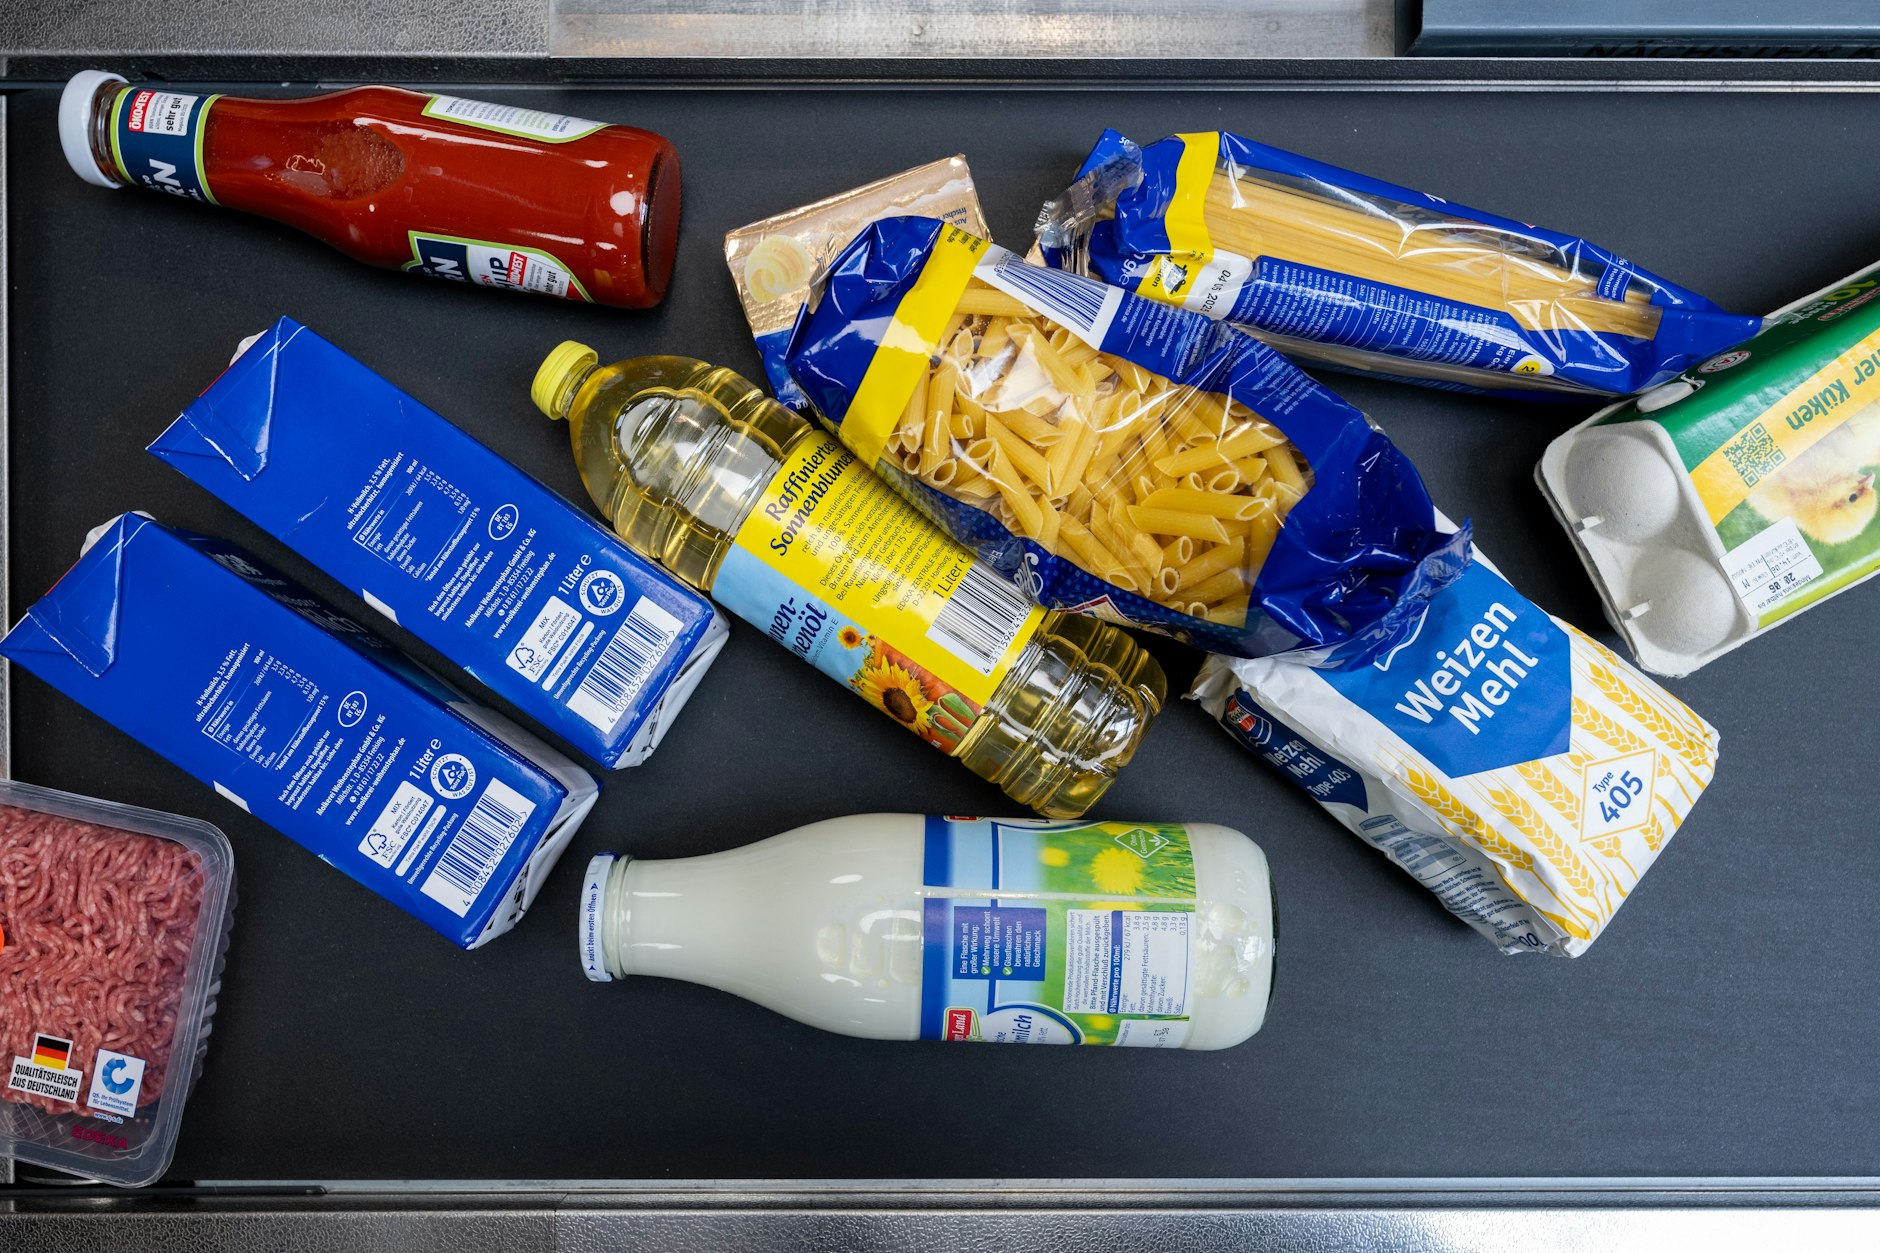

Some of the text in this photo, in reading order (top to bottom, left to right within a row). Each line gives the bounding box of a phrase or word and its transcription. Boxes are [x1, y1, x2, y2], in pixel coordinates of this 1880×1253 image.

[172, 97, 183, 109] gut
[1786, 379, 1851, 430] Küken
[347, 485, 372, 513] H-Vollmilch,
[378, 458, 390, 470] Fett,
[347, 452, 403, 529] ultrahocherhitzt, homogenisiert
[766, 440, 836, 521] Raffiniertes
[801, 533, 816, 553] reich
[823, 483, 852, 520] natürlichem
[810, 493, 857, 556] und ungesättigten
[828, 502, 892, 589] Braten zum Anrichten
[879, 525, 902, 553] Gebrauch
[894, 535, 906, 547] 175
[819, 564, 837, 586] Dieses
[855, 521, 866, 534] sich
[843, 534, 884, 588] Raumtemperatur
[872, 531, 924, 602] Ungeöffnet mindestens
[904, 551, 920, 573] oberer
[465, 604, 484, 627] Molkerei
[481, 566, 511, 604] Weihenstephan
[508, 549, 522, 566] GmbH
[484, 550, 534, 617] Milchstr. Freising
[562, 564, 583, 588] Liter
[580, 572, 598, 595] SCHÜTZT
[896, 558, 935, 611] EDEKA ZENTRALE
[937, 563, 961, 591] Liter
[598, 595, 608, 606] Tetra
[601, 607, 613, 615] WAS
[613, 595, 623, 608] GUT
[912, 578, 933, 606] D-22291
[538, 616, 549, 628] MIX
[558, 615, 576, 640] C014047
[819, 626, 834, 649] Vitamin
[987, 630, 1014, 662] 311596
[196, 676, 220, 705] H-Vollmilch,
[225, 649, 238, 661] Fett,
[528, 654, 544, 672] FSC
[614, 674, 644, 711] 008452
[640, 636, 672, 673] 027602
[1395, 602, 1517, 724] Weizen
[196, 643, 249, 721] ultrahocherhitzt, homogenisiert
[553, 666, 579, 698] Umweltgerechte
[1449, 640, 1538, 735] Mehl
[413, 748, 433, 772] Liter
[1263, 739, 1308, 767] Weizen
[1287, 752, 1326, 779] Mehl
[316, 791, 335, 815] Molkerei
[332, 753, 362, 792] Weihenstephan
[358, 735, 372, 752] GmbH
[335, 736, 384, 804] Milchstr. Freising
[432, 756, 450, 780] SCHÜTZT
[1592, 772, 1613, 792] Type
[466, 779, 474, 790] GUT
[1306, 768, 1352, 797] Type 405
[1599, 771, 1642, 821] 405
[390, 801, 401, 814] MIX
[410, 799, 428, 825] C014047
[381, 840, 396, 858] FSC
[469, 858, 501, 894] 008452
[493, 818, 526, 855] 027602
[586, 893, 597, 912] Öffnen
[952, 1013, 965, 1033] Land
[11, 1076, 76, 1100] AUS DEUTSCHLAND
[14, 1064, 78, 1088] QUALITÄTSFLEISCH
[108, 1096, 134, 1108] Prüfsystem
[71, 1127, 128, 1150] EDEKA
